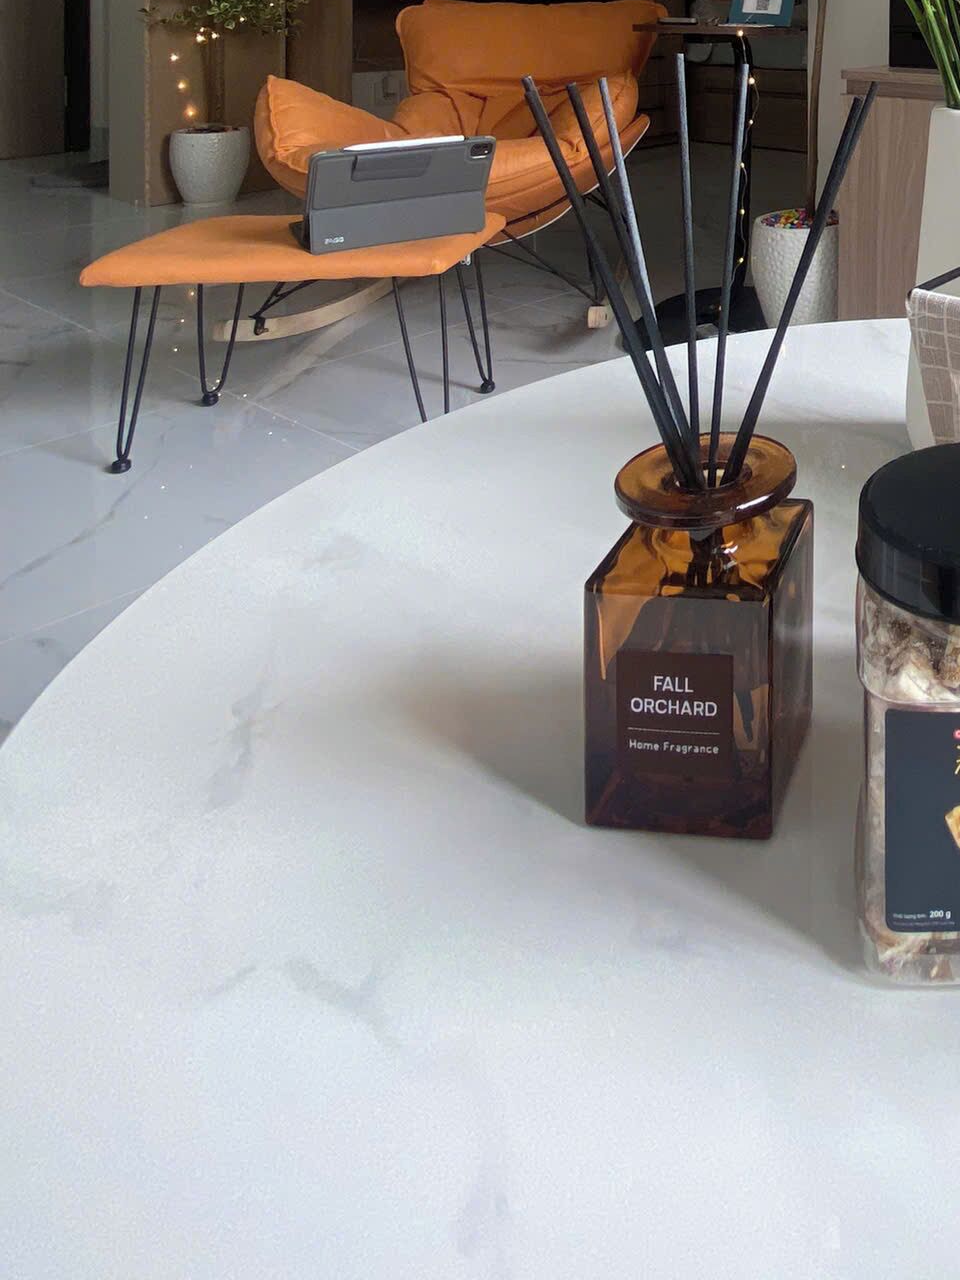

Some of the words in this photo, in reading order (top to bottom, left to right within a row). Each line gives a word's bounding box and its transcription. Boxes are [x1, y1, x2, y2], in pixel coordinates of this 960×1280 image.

[653, 675, 694, 693] FALL
[630, 697, 718, 716] ORCHARD
[629, 738, 659, 751] Home
[663, 741, 719, 754] Fragrance
[929, 910, 944, 918] 200
[945, 910, 951, 920] g
